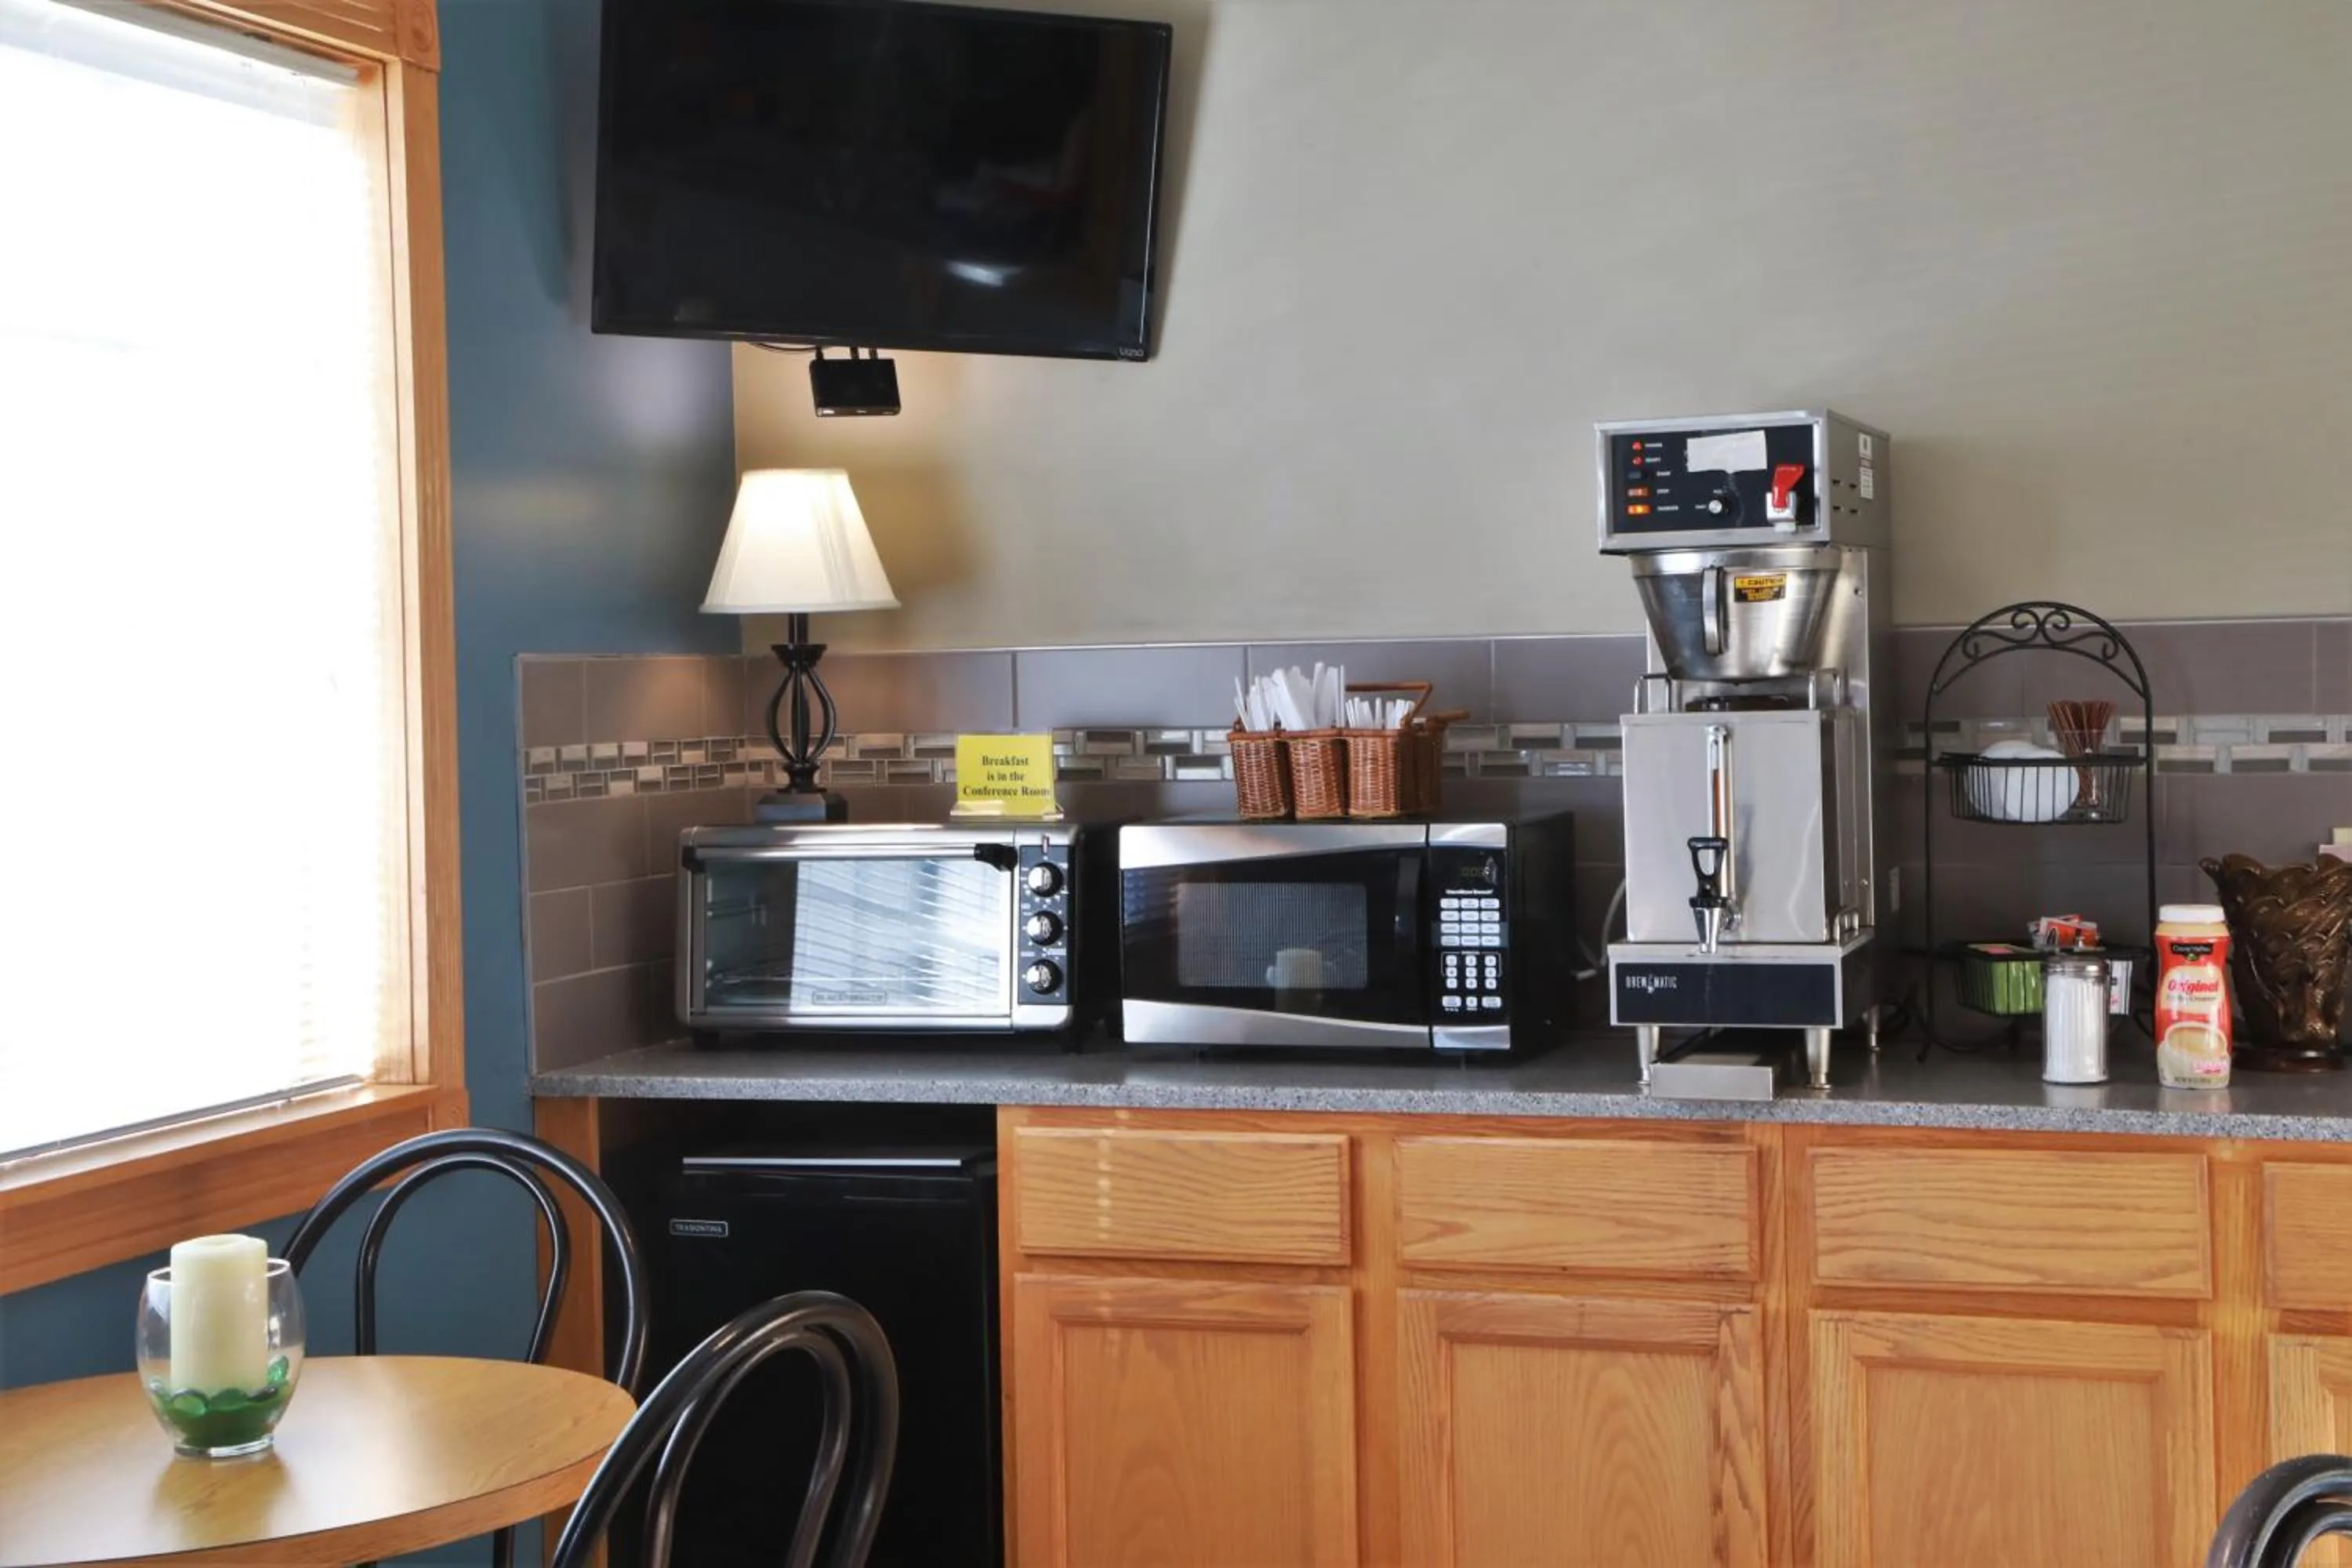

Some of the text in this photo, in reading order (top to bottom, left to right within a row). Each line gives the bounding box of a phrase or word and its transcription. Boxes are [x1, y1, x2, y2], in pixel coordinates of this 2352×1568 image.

[982, 755, 1029, 766] Breakfast
[987, 771, 1025, 782] is in the
[963, 786, 1050, 797] Conference Room
